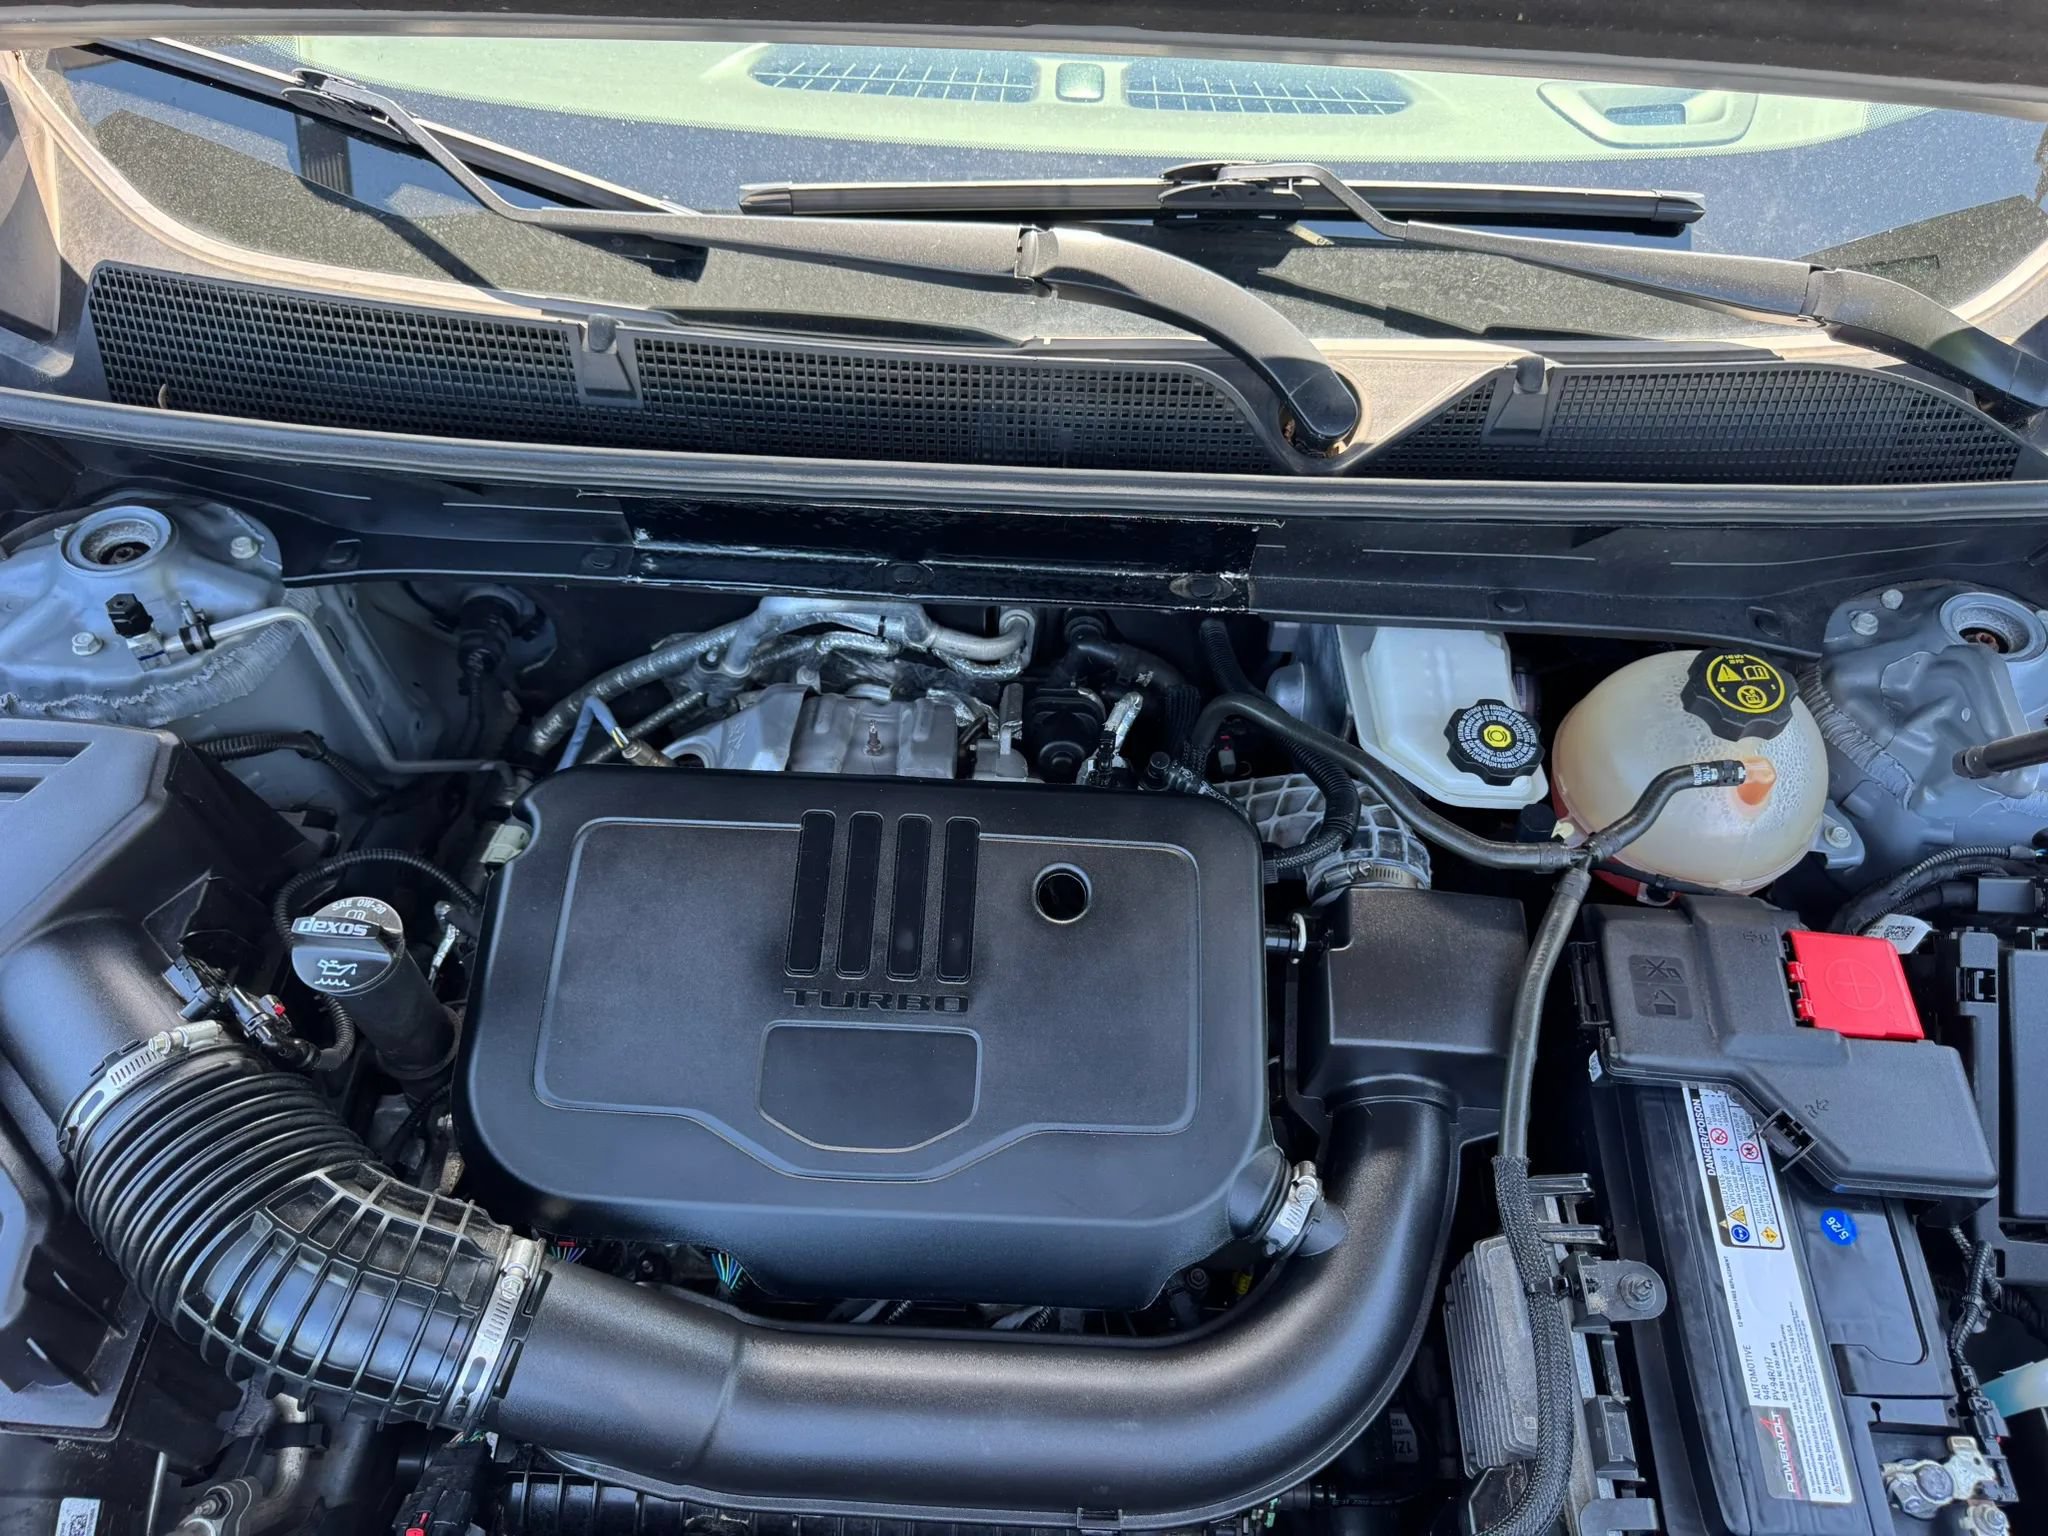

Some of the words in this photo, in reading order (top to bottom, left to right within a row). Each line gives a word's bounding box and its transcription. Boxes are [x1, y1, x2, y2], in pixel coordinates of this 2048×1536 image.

[1482, 759, 1497, 768] FROM
[332, 899, 352, 911] SAE
[356, 899, 386, 914] 0W-20
[298, 917, 371, 936] dexos
[783, 987, 969, 1013] TURBO
[1706, 1116, 1712, 1125] NO
[1719, 1101, 1728, 1122] SMOKING
[1692, 1098, 1715, 1175] DANGER/POISON
[1720, 1155, 1729, 1174] GASES
[1725, 1175, 1736, 1206] EXPLOSIVE
[1732, 1177, 1740, 1192] CAUSE
[1722, 1190, 1731, 1210] SHIELD
[1758, 1203, 1766, 1216] WITH
[1754, 1207, 1762, 1223] FLUSH
[1765, 1202, 1775, 1224] MEDICAL
[1825, 1215, 1849, 1241] 5/26
[1723, 1256, 1734, 1288] REPLACEMENT
[1742, 1344, 1761, 1399] AUTOMOTIVE
[1764, 1356, 1781, 1400] PV-94R/H7
[1761, 1384, 1771, 1399] 94R
[1809, 1425, 1820, 1452] Interstate
[1770, 1410, 1796, 1492] POWERVOLT
[1818, 1462, 1831, 1494] Distributed
